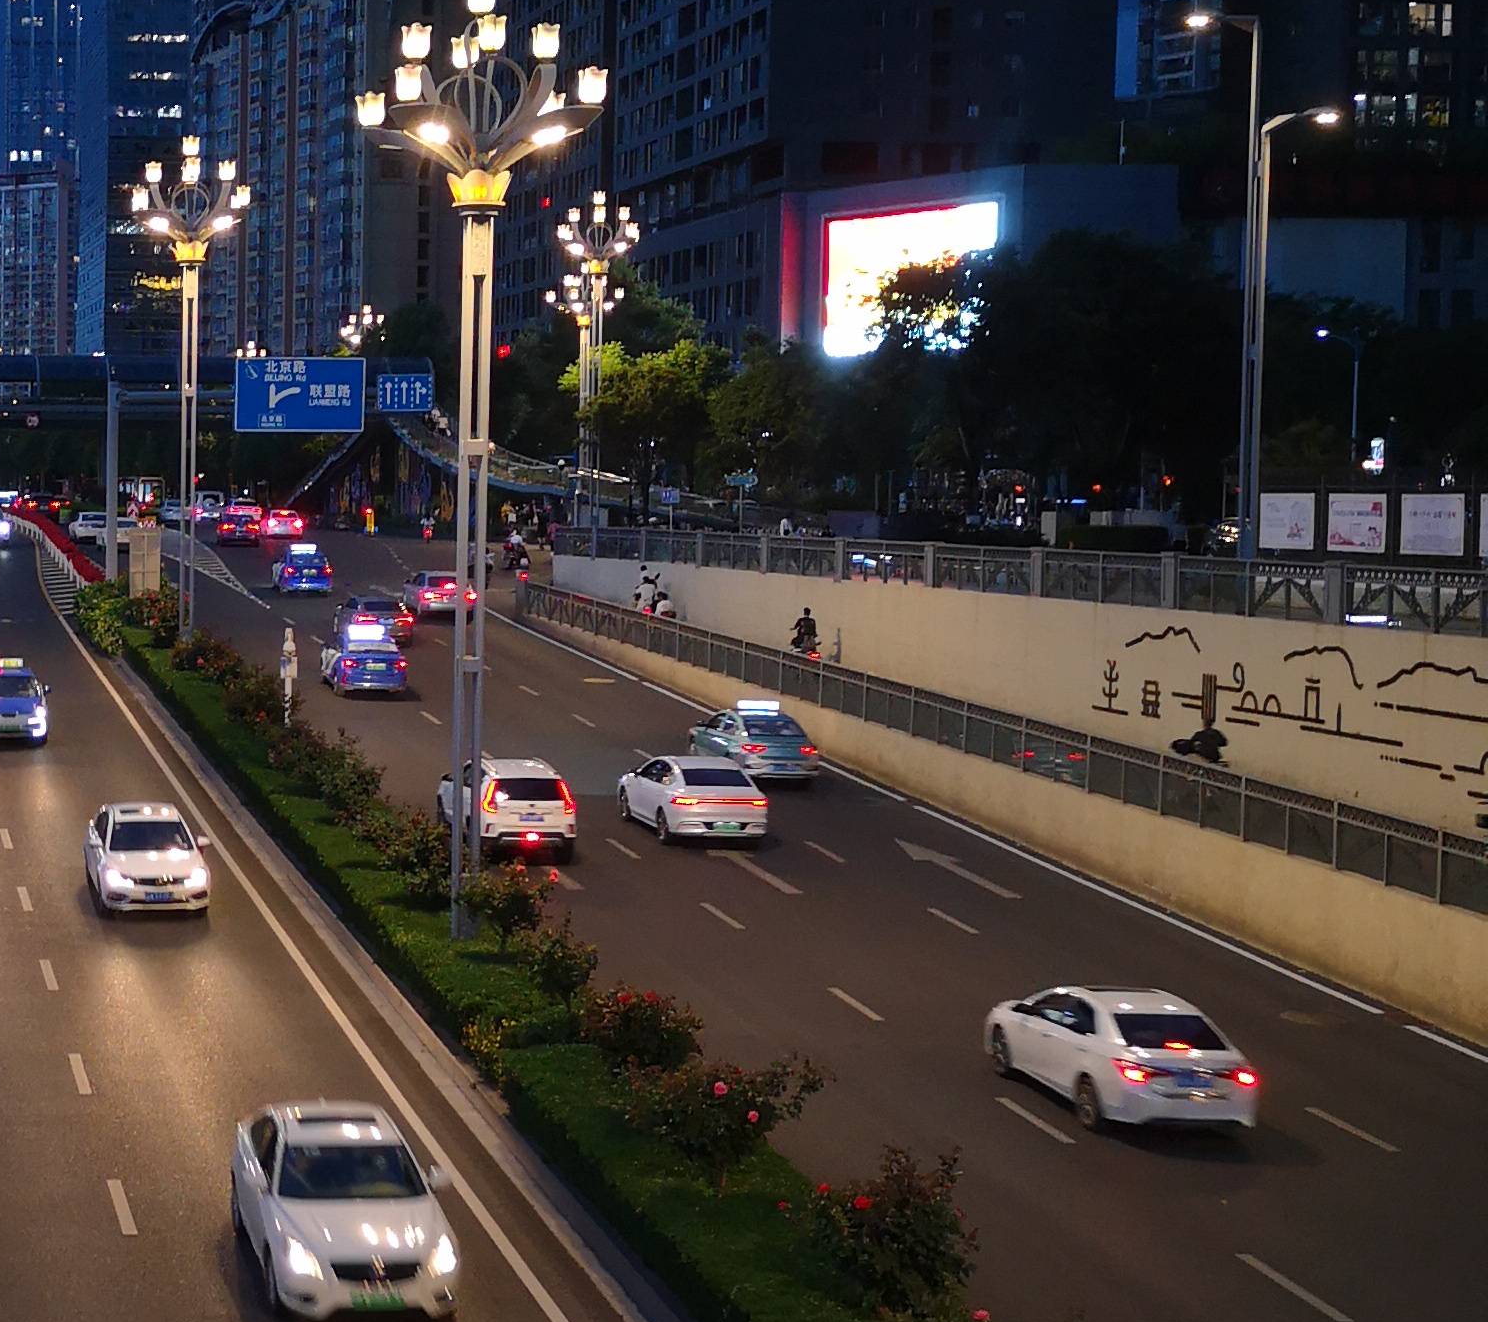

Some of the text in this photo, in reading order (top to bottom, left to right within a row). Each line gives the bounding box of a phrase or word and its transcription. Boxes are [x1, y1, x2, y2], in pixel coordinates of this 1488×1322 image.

[265, 360, 306, 374] 北京路
[309, 384, 351, 398] 联盟路
